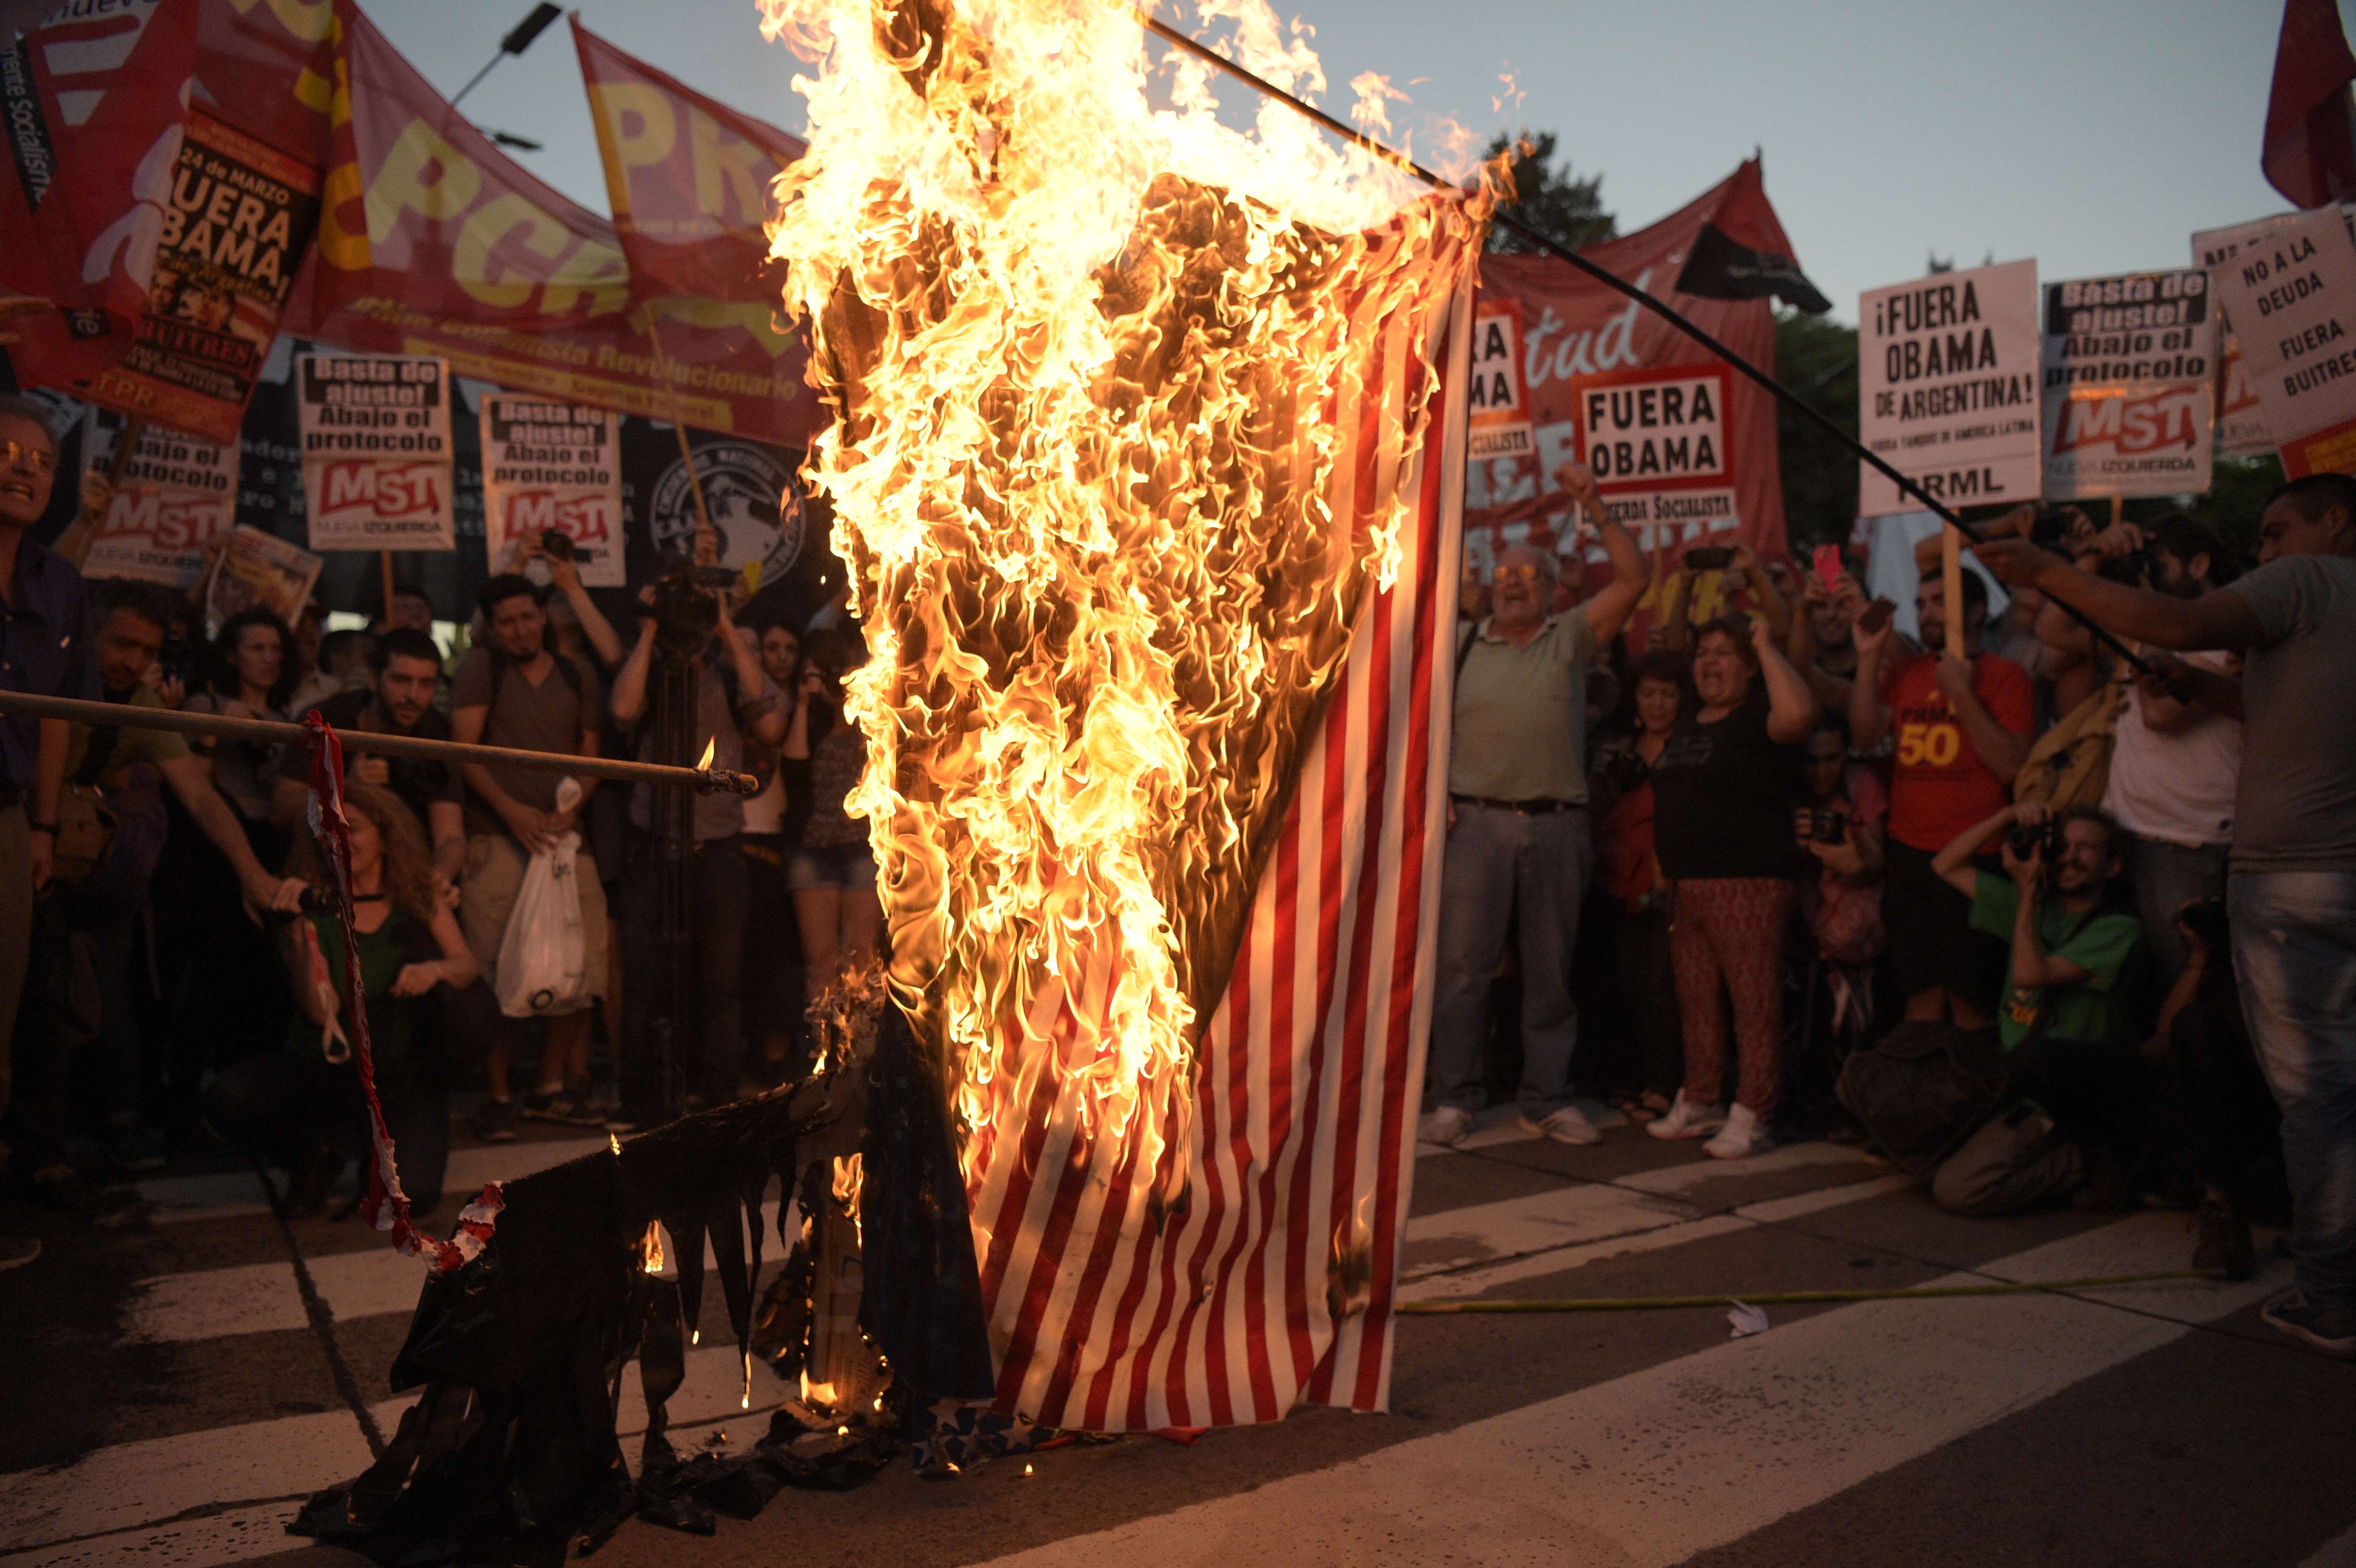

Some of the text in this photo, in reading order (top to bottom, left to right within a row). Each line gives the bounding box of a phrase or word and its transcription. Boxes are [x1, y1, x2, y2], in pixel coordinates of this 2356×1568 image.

[180, 147, 290, 206] 24 de MARZO
[173, 167, 290, 251] UERA
[160, 205, 290, 308] BAMA!
[2242, 259, 2270, 289] NO
[2274, 250, 2289, 274] A
[2289, 235, 2317, 264] LA
[1876, 281, 1980, 336] ¡FUERA
[2063, 273, 2204, 306] Basta de
[2257, 269, 2325, 317] DEUDA
[1887, 327, 1997, 383] OBAMA
[2061, 327, 2193, 358] Abajo el
[2280, 317, 2345, 361] FUERA
[314, 359, 436, 382] Basta de
[597, 344, 799, 403] Revolucionario
[2046, 355, 2206, 386] protocolo
[318, 407, 430, 428] Abajo el
[326, 384, 425, 408] ajuste!
[500, 403, 604, 425] Basta de
[1589, 384, 1714, 432] FUERA
[1875, 373, 2033, 421] DE ARGENTINA!
[306, 432, 443, 452] protocolo
[2067, 393, 2195, 449] MST
[196, 446, 220, 466] el
[493, 467, 610, 486] protocolo
[503, 445, 600, 464] Abajo el
[1592, 435, 1716, 477] OBAMA
[2102, 457, 2195, 473] IZQUIERDA
[328, 465, 442, 512] MST
[106, 493, 222, 547] MST
[512, 496, 605, 541] MST
[1897, 722, 1960, 767] 50
